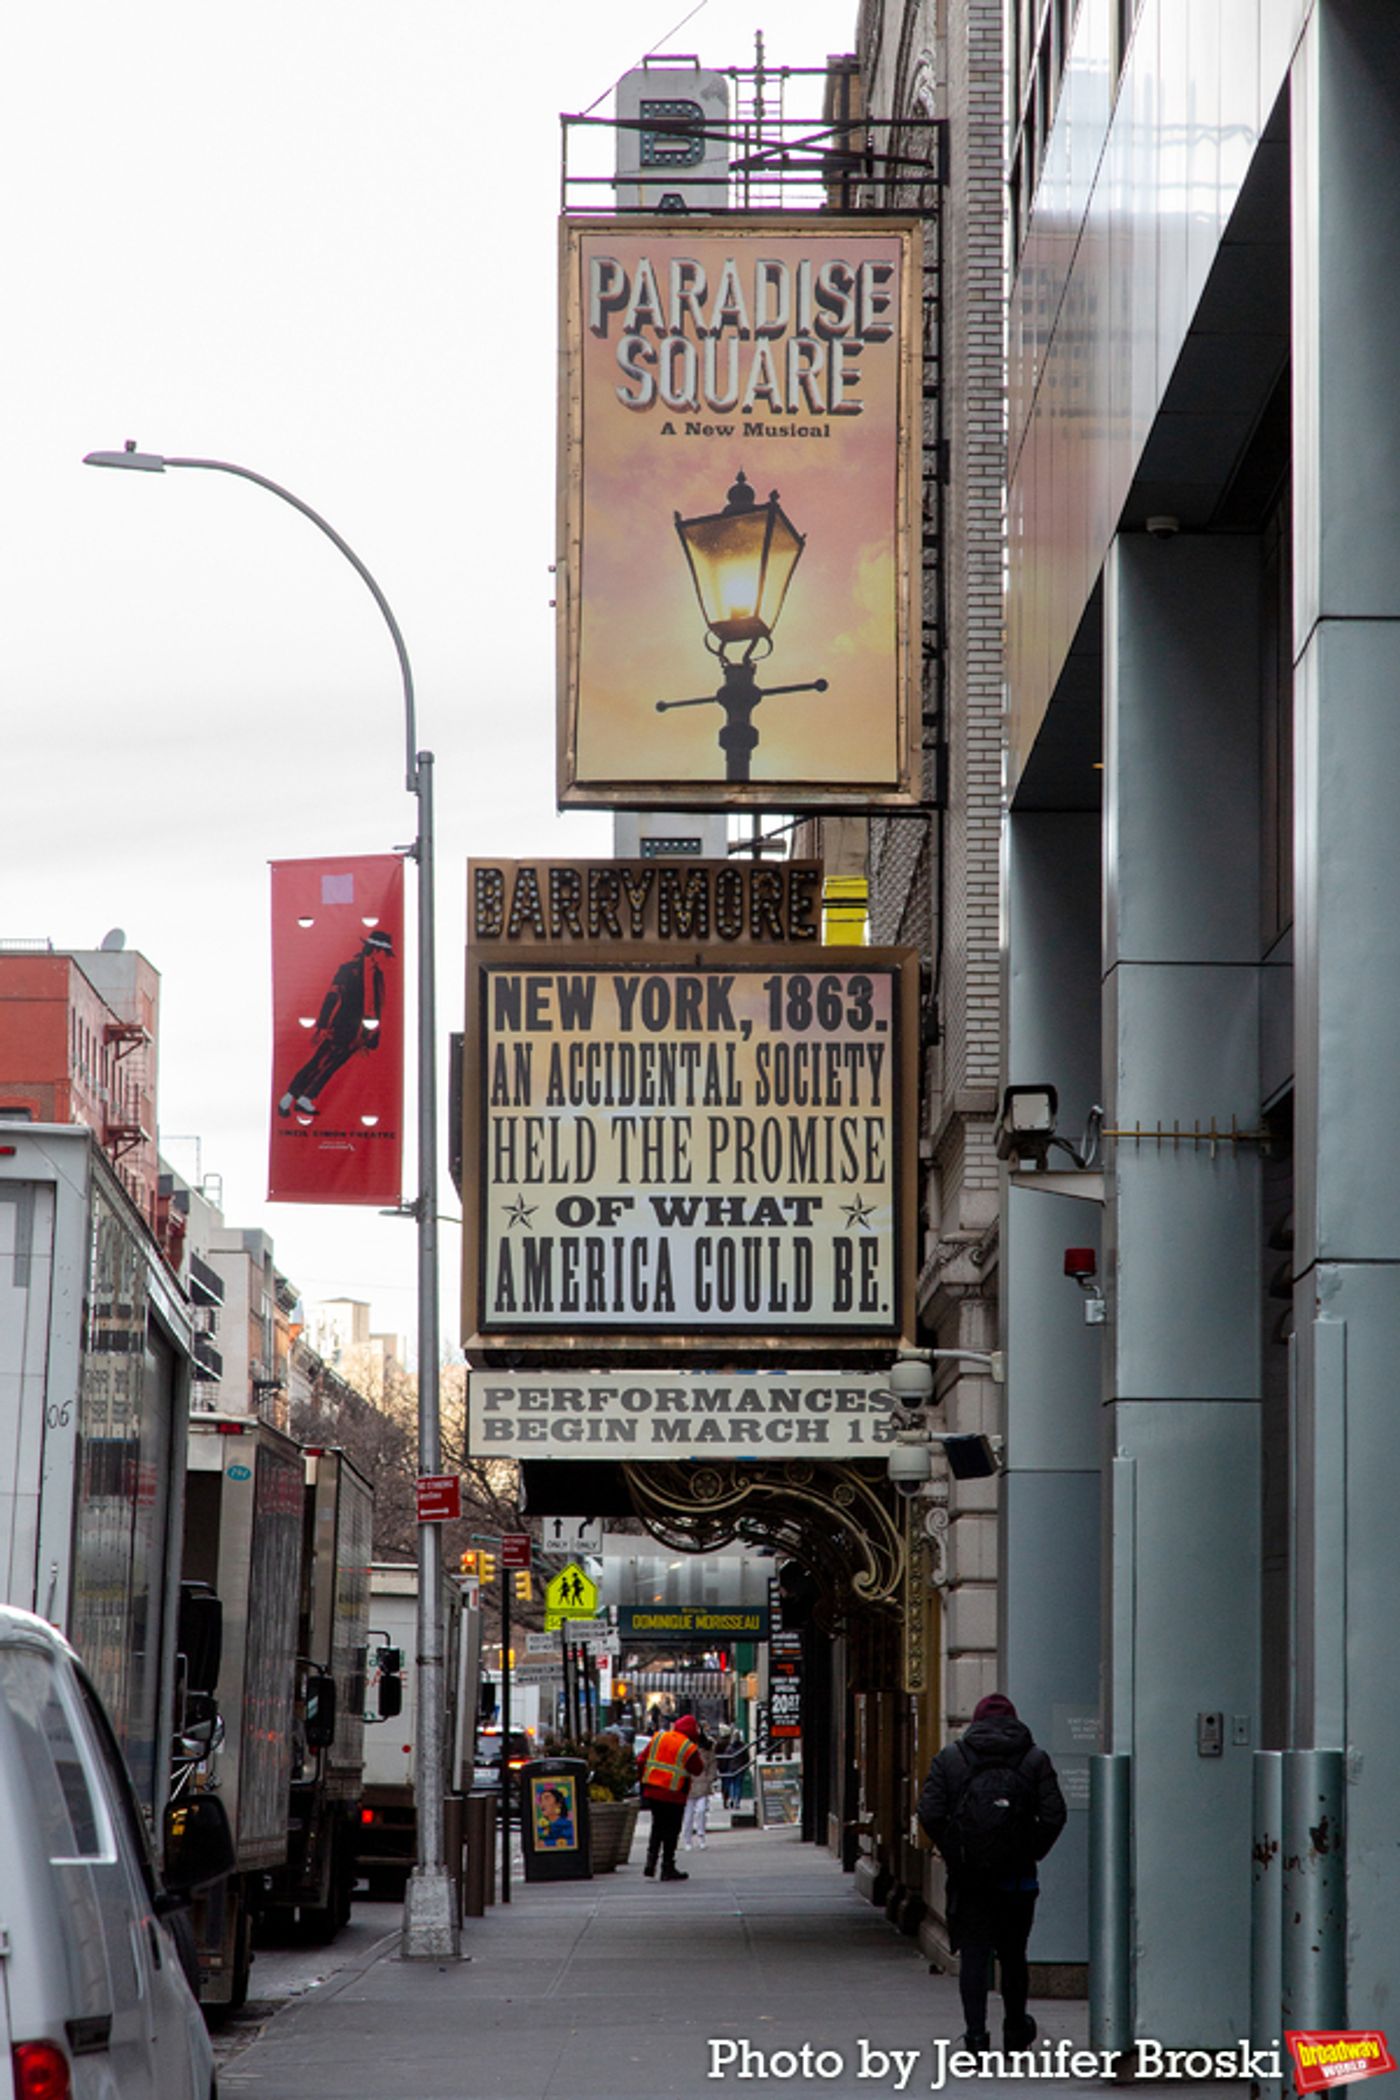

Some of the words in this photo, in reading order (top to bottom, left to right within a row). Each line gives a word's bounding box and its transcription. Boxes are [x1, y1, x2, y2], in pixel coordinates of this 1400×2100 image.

[588, 256, 896, 342] PARADISE
[615, 333, 866, 416] SQUARE
[661, 422, 677, 436] A
[685, 422, 734, 437] New
[742, 422, 831, 438] Musical
[474, 867, 818, 940] BARRYMORE
[494, 975, 597, 1032] NEW
[614, 975, 753, 1041] YORK,
[763, 975, 889, 1032] 1863.
[491, 1041, 533, 1107] AN
[546, 1041, 742, 1107] ACCIDENTAL
[756, 1041, 886, 1107] SOCIETY
[492, 1115, 597, 1185] HELD
[611, 1115, 693, 1185] THE
[707, 1115, 887, 1185] PROMISE
[555, 1195, 634, 1227] OF
[649, 1195, 823, 1227] WHAT
[494, 1236, 676, 1313] AMERICA
[695, 1236, 813, 1313] COULD
[832, 1236, 889, 1313] BE.
[483, 1387, 895, 1414] PERFORMANCES
[483, 1418, 639, 1442] BEGIN
[651, 1418, 830, 1442] MARCH
[848, 1418, 897, 1442] 15
